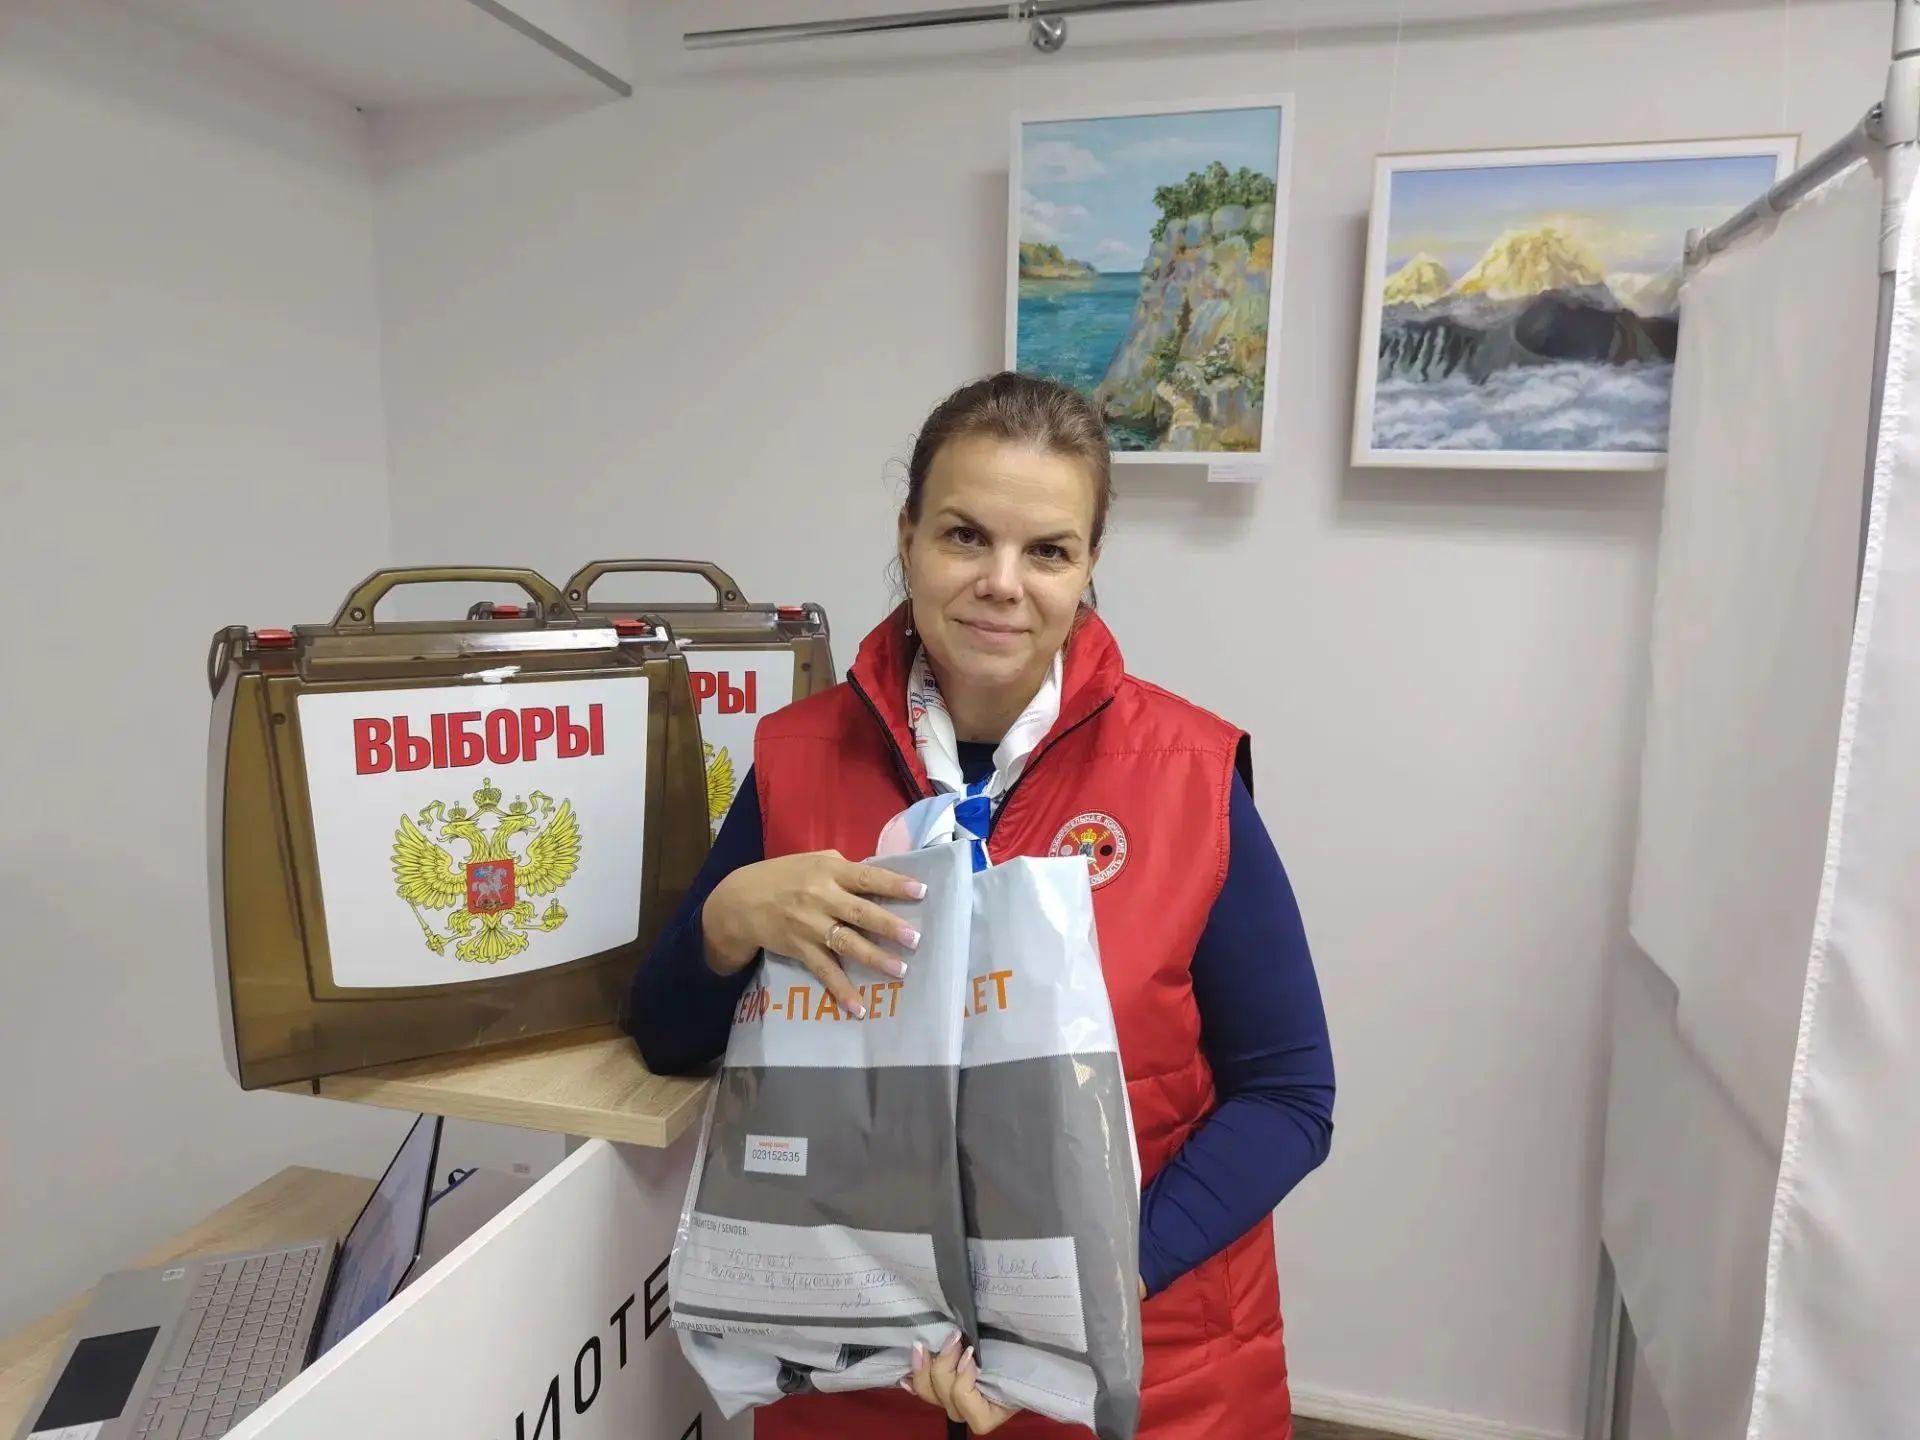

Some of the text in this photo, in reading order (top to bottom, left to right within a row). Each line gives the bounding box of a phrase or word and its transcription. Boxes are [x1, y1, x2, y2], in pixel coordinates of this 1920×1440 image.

[353, 703, 605, 775] ВЫБОРЫ
[964, 970, 1013, 1018] ЕТ
[752, 1149, 800, 1162] 023152535
